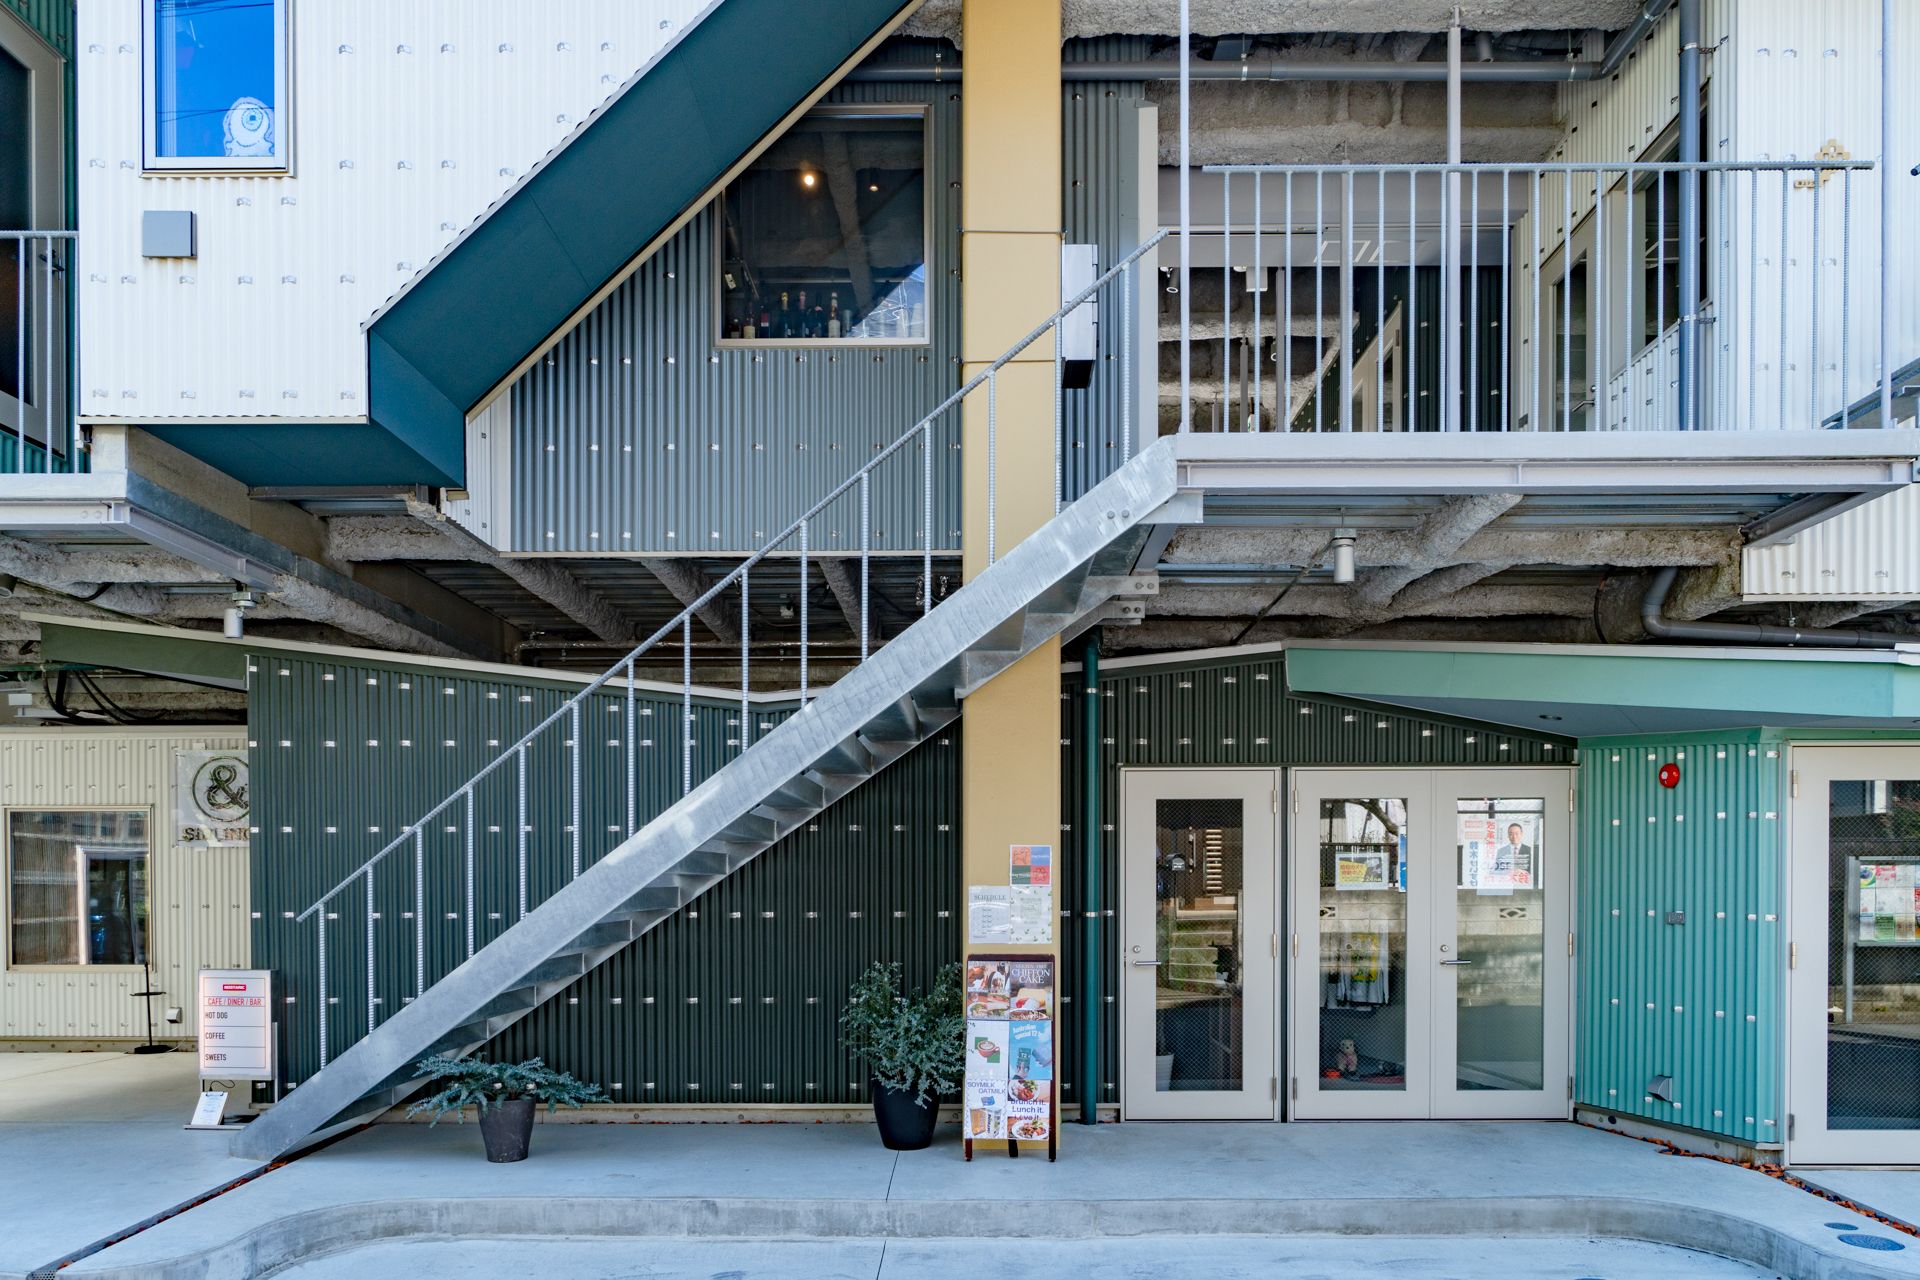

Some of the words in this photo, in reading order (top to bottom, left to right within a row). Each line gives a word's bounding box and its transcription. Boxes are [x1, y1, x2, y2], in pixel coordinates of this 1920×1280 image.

[1011, 968, 1050, 976] CHIFFON
[1019, 975, 1044, 983] CAKE
[228, 998, 244, 1006] DINER
[250, 998, 261, 1006] BAR
